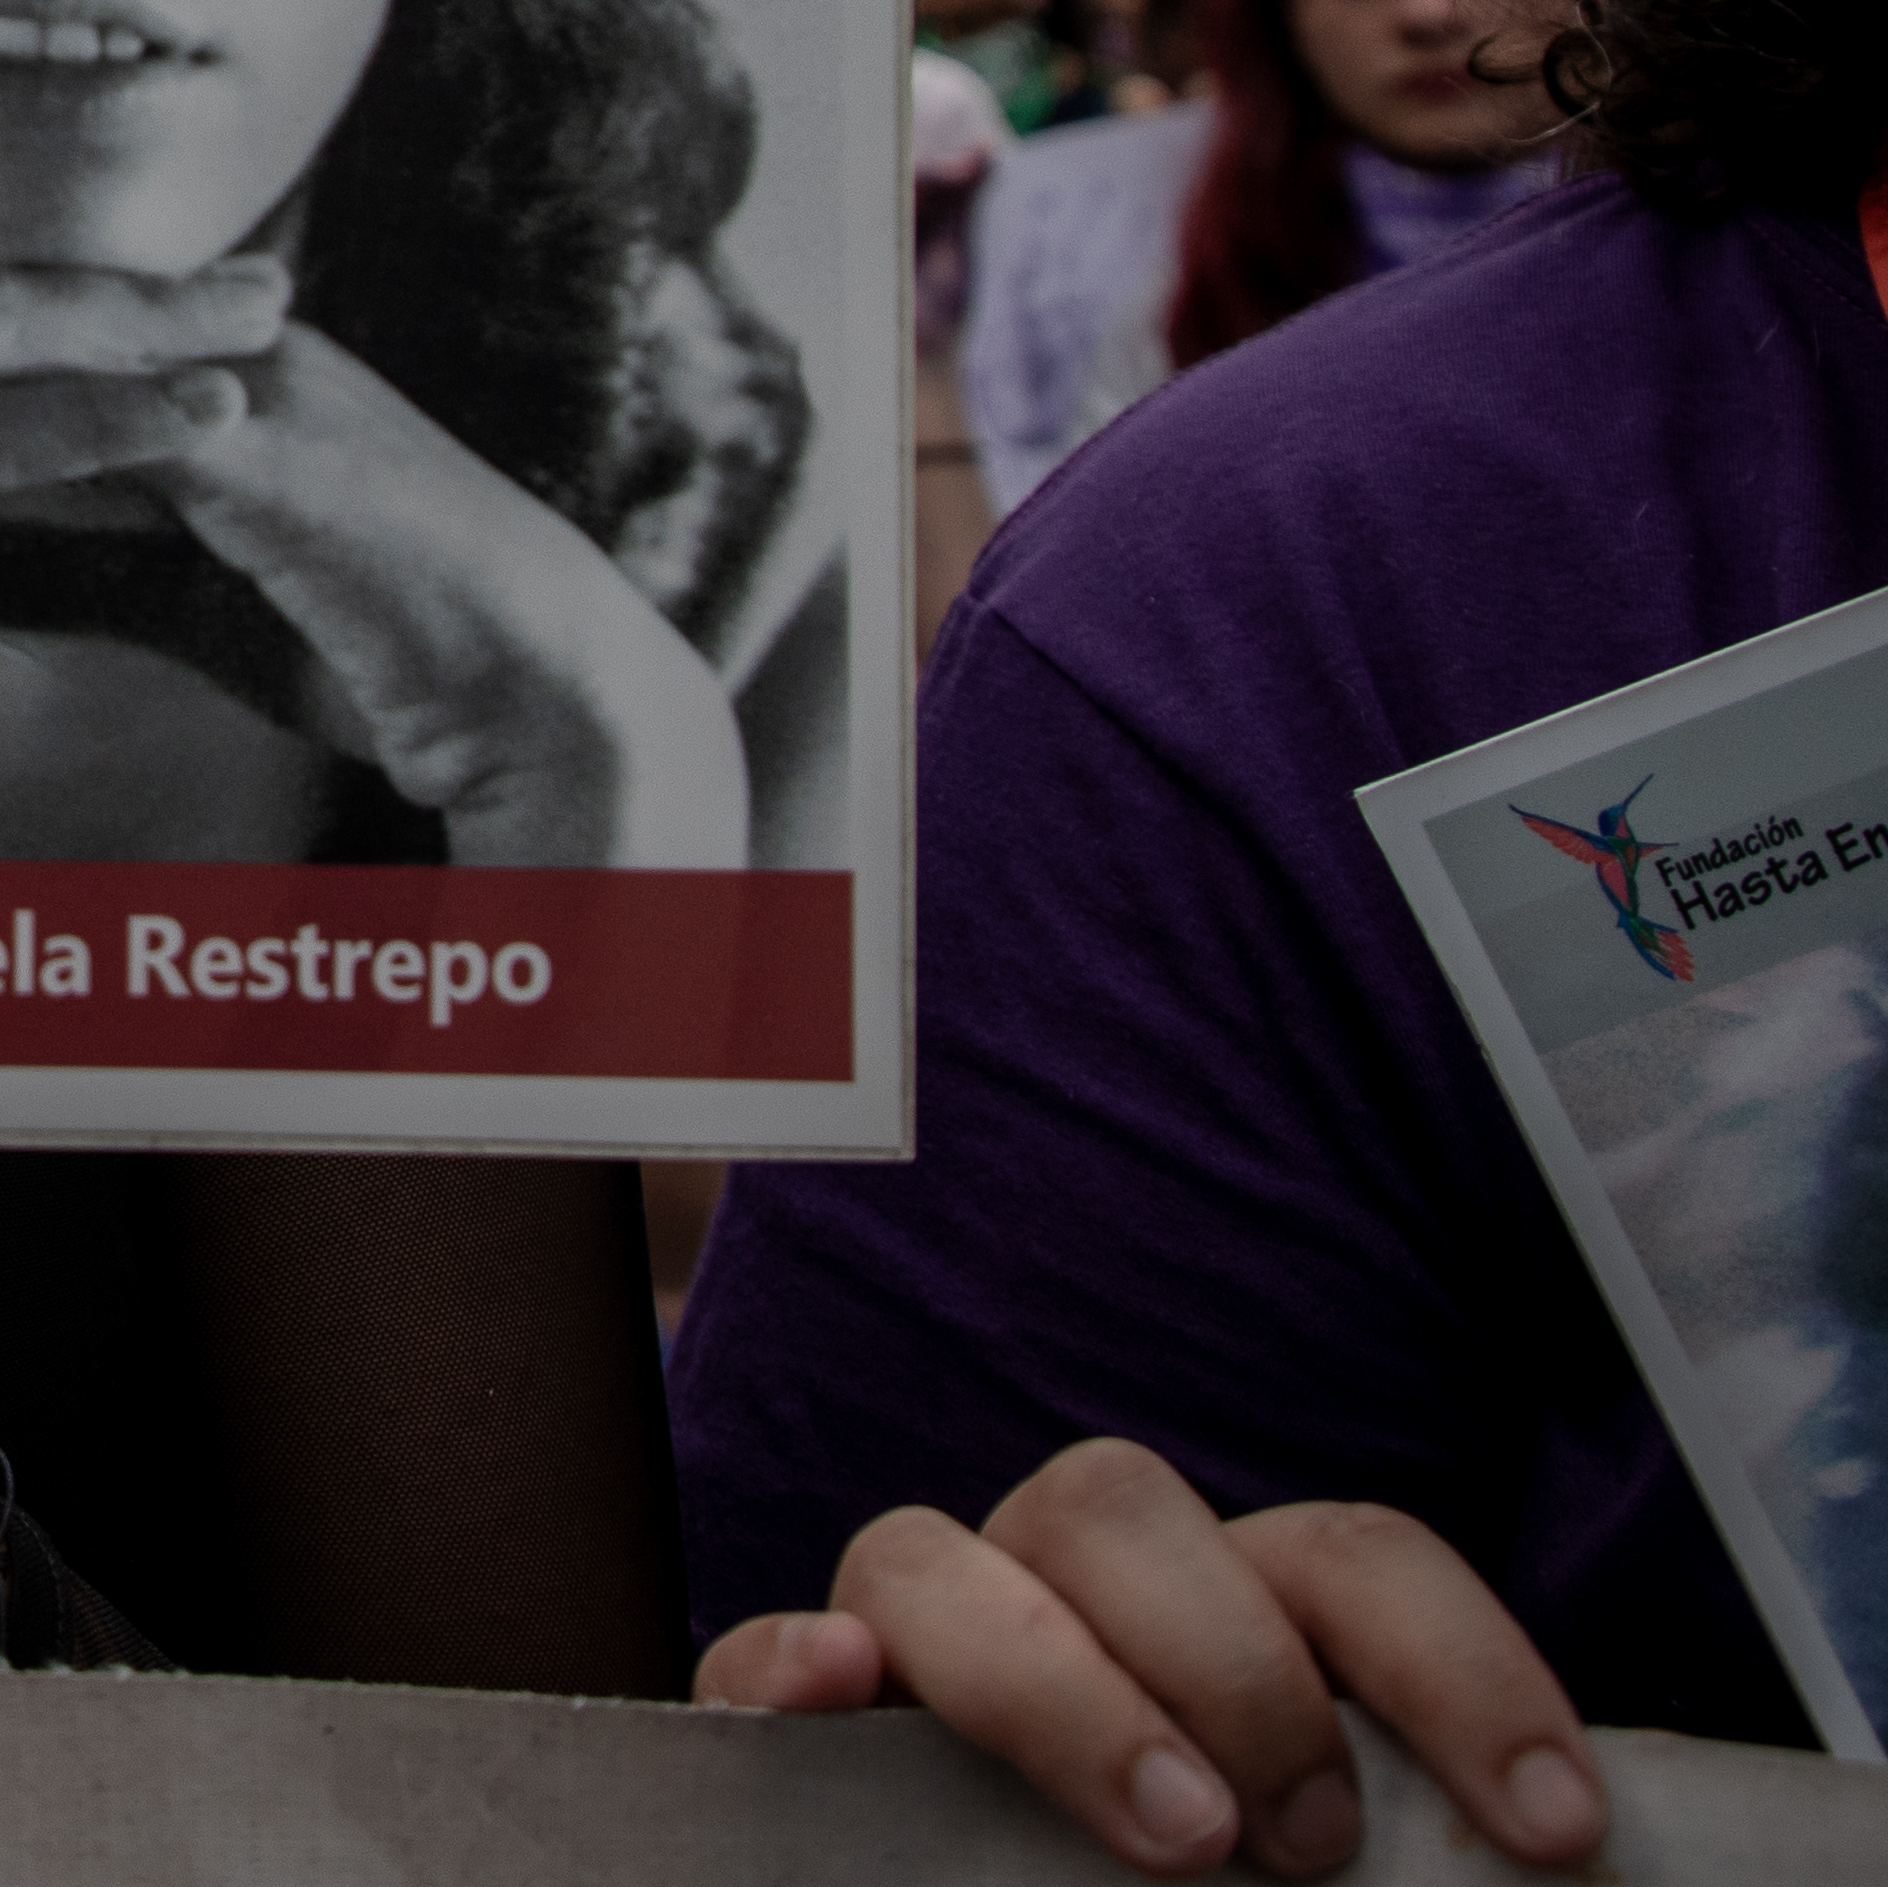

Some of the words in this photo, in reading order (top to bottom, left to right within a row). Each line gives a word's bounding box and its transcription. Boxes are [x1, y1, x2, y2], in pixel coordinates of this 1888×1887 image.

[1655, 815, 1804, 888] Fundación
[1670, 849, 1829, 930] Hasta
[125, 913, 553, 1028] Restrepo
